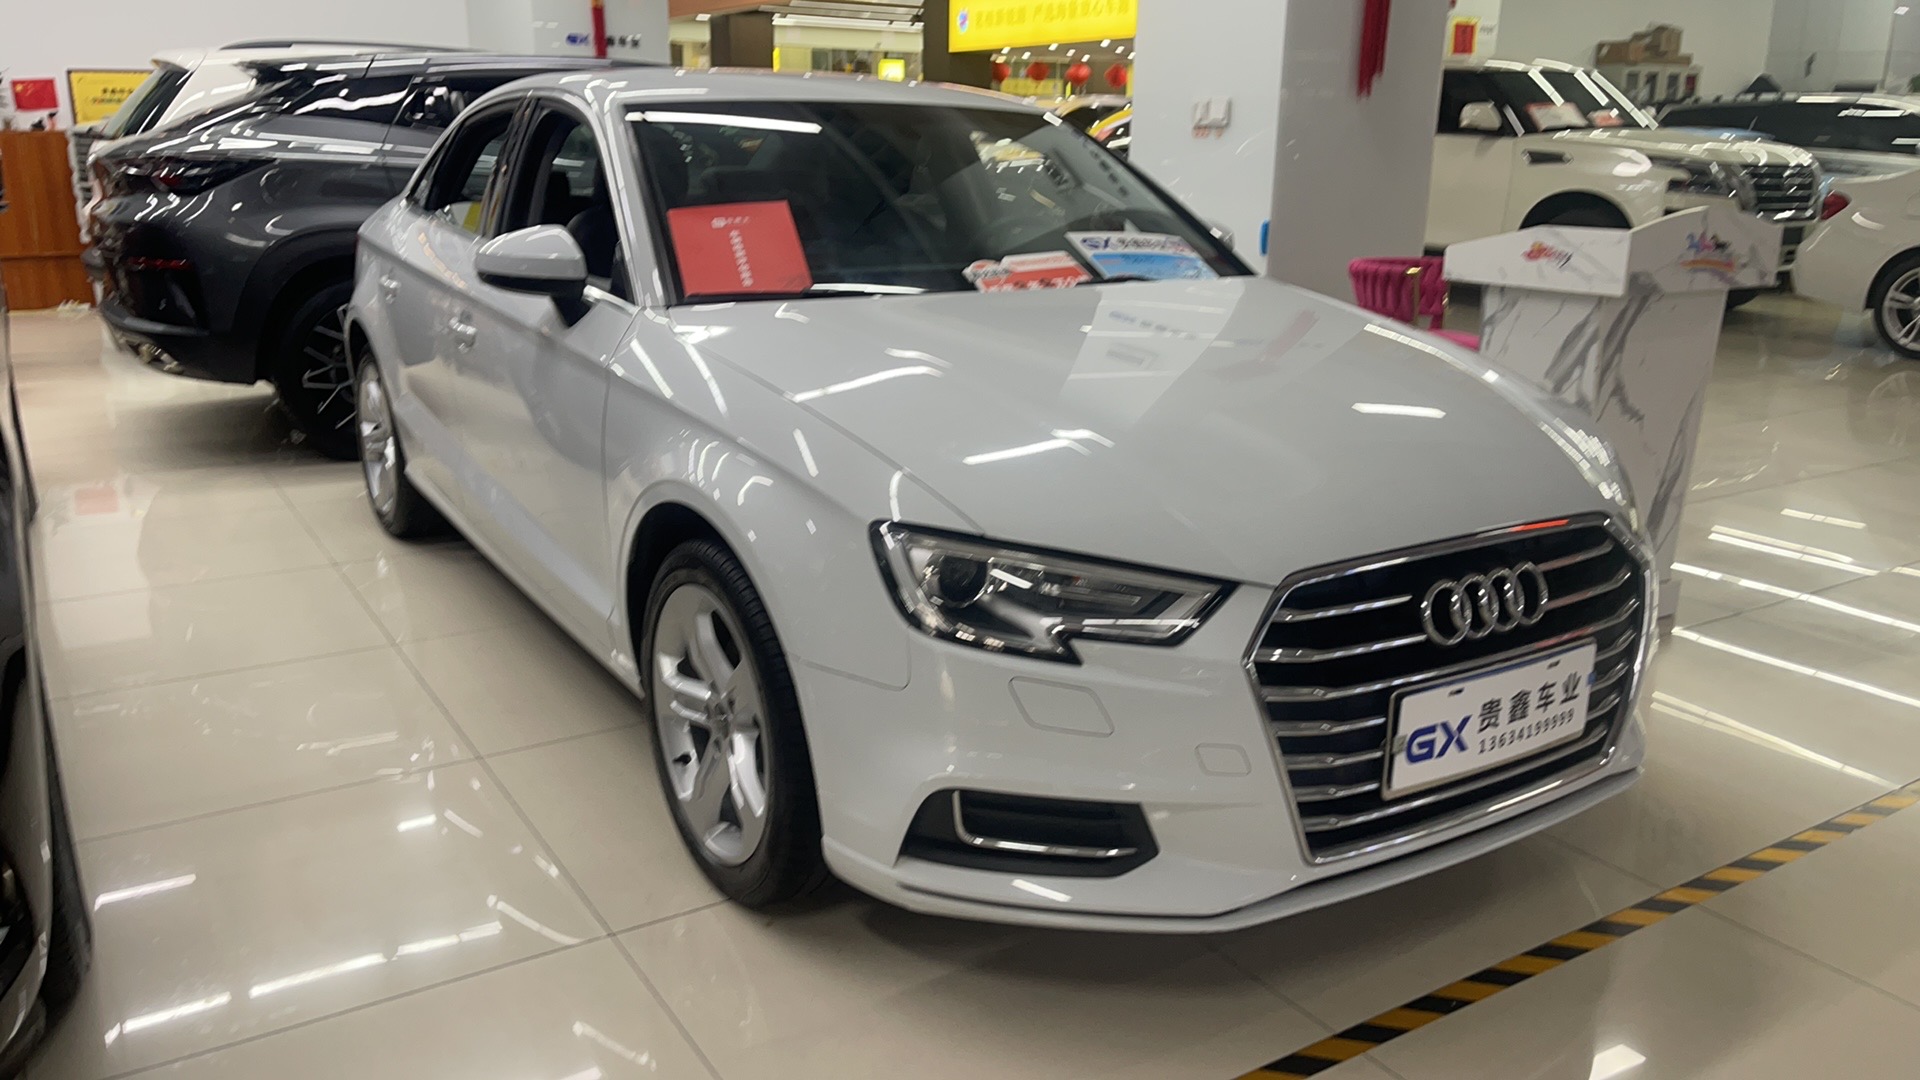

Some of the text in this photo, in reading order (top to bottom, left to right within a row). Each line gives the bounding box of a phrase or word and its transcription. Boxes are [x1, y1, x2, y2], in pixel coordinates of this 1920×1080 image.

[1477, 671, 1582, 734] 贵鑫车业
[1405, 714, 1472, 765] GX
[1478, 707, 1575, 755] 13634199999
